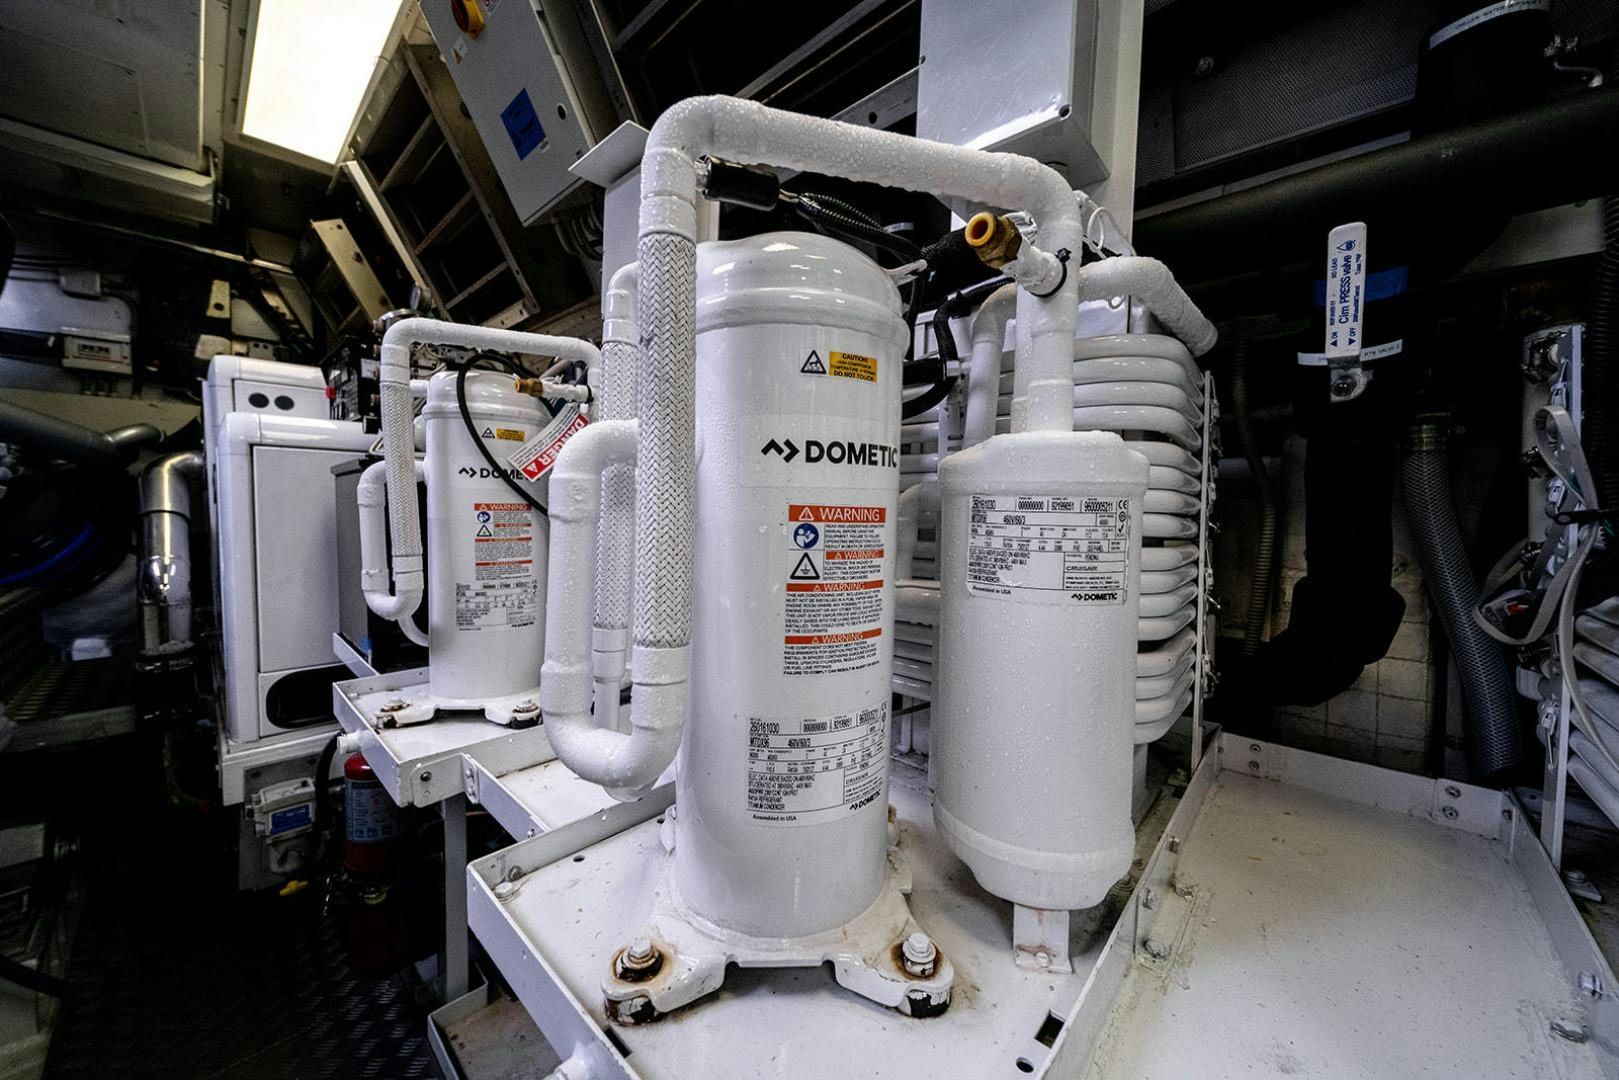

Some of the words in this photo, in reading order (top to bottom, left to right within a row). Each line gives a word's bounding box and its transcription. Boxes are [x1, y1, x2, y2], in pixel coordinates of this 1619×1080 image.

[1341, 255, 1352, 276] valve
[1339, 276, 1351, 304] PRESS
[1338, 306, 1350, 324] Cim
[842, 354, 868, 362] CAUTION!
[805, 440, 897, 468] DOMETIC
[820, 508, 880, 521] WARNING
[844, 551, 880, 560] WARNING
[823, 582, 865, 591] WARNING
[1084, 592, 1117, 601] DOMETIC
[822, 632, 863, 643] WARNING
